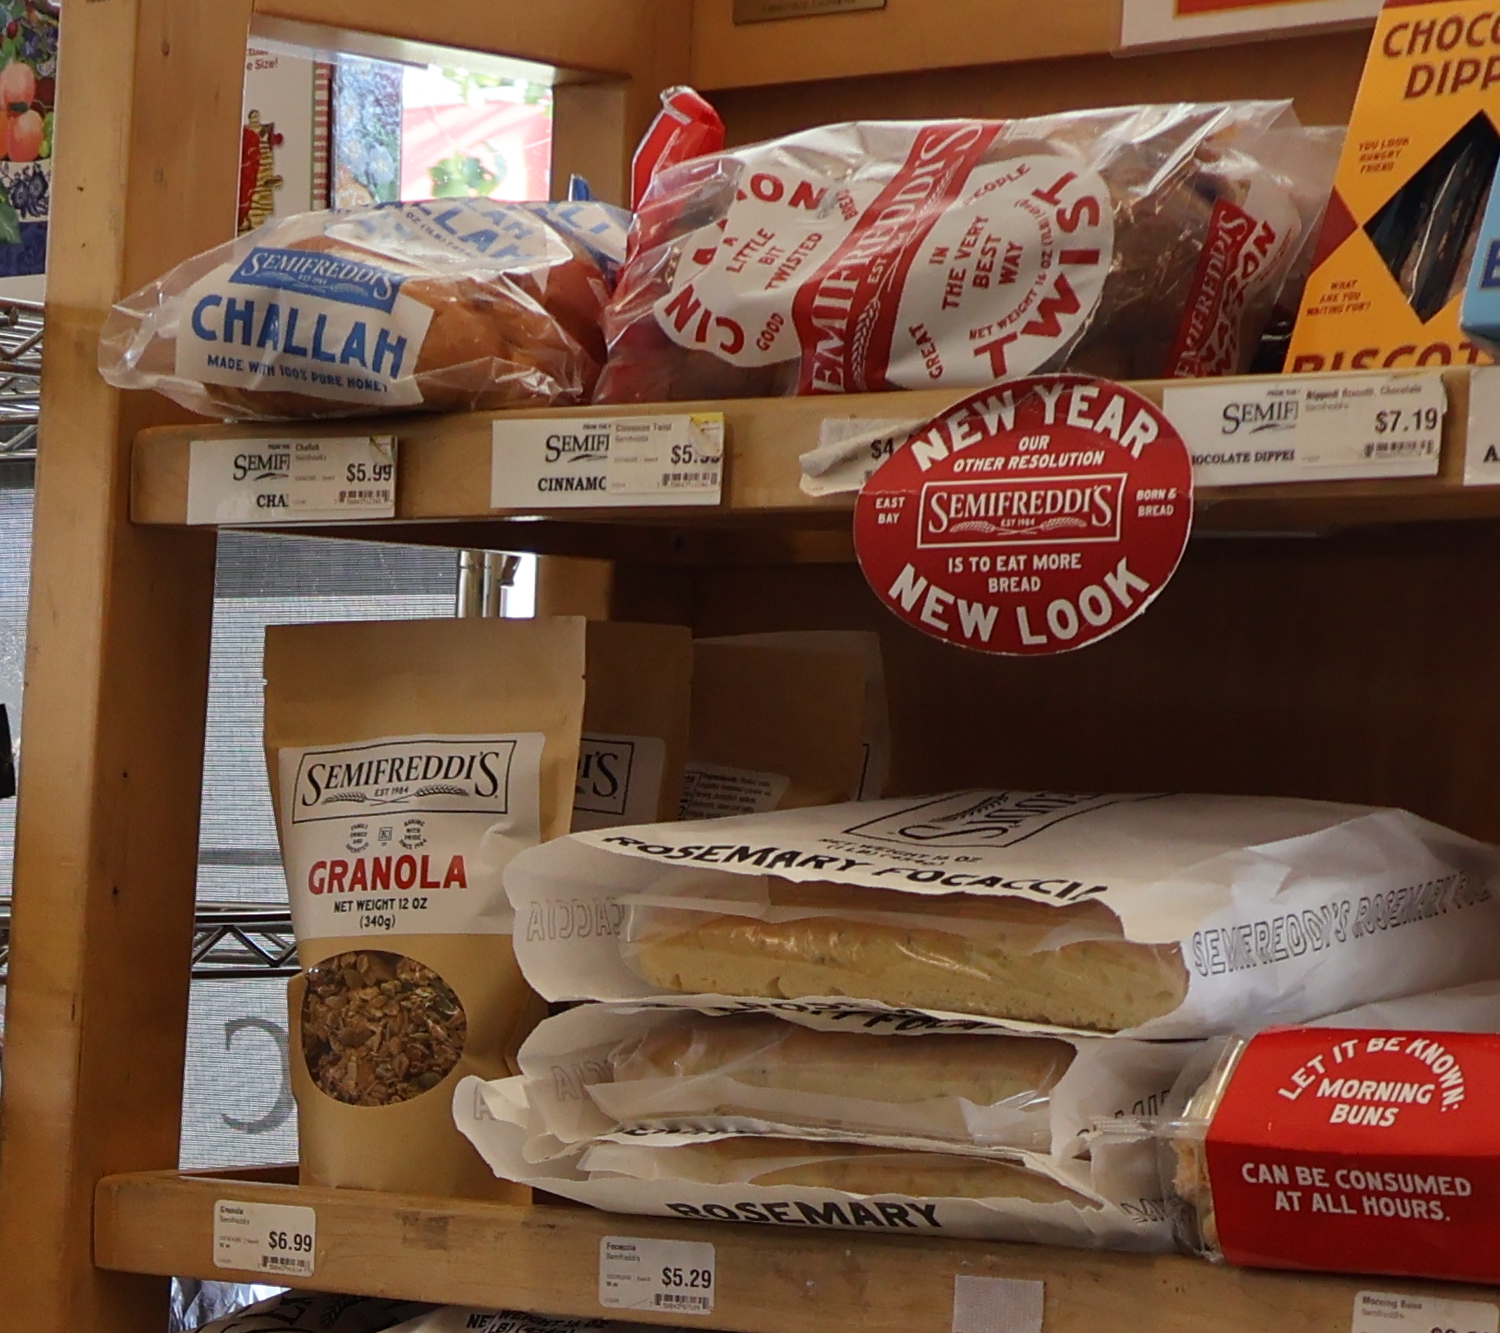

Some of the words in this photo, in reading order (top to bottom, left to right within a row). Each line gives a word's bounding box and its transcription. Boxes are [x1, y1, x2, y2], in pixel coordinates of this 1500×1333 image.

[726, 228, 775, 274] LITTLE
[760, 245, 785, 266] BIT
[954, 215, 990, 271] VERY
[240, 250, 394, 302] SEMIFREDDI'S
[765, 232, 824, 291] TWISTED
[972, 234, 1001, 290] BEST
[973, 171, 1101, 380] TWIST
[998, 241, 1025, 287] WAY
[942, 266, 969, 311] THE
[191, 294, 407, 379] CHALLAH
[206, 354, 244, 372] MADE
[248, 358, 276, 375] WITH
[278, 364, 308, 380] 100%
[312, 371, 343, 388] PURE
[911, 389, 1017, 472] NEW
[1033, 382, 1160, 460] YEAR
[1374, 407, 1438, 435] $7.19
[1018, 434, 1050, 451] OUR
[346, 461, 393, 483] $5.99
[953, 455, 1006, 473] OTHER
[1008, 450, 1105, 470] RESOLUTION
[875, 496, 906, 510] EAST
[928, 484, 1113, 534] SEMIFREDDI'S
[1136, 488, 1168, 501] BORN
[1169, 488, 1177, 499] &
[1137, 503, 1174, 517] BREAD
[878, 511, 900, 525] BAY
[948, 557, 964, 574] IS
[969, 557, 991, 573] TO
[996, 554, 1029, 572] EAT
[1032, 553, 1082, 571] MORE
[988, 576, 1041, 594] BREAD
[888, 561, 1000, 643] NEW
[1016, 557, 1151, 647] LOOK
[301, 750, 500, 806] SEMIFREDDI'S
[602, 833, 877, 877] ROSEMARY
[308, 853, 468, 896] GRANOLA
[333, 898, 354, 914] NET
[355, 897, 396, 913] WEIGHT
[397, 896, 410, 911] 12
[411, 895, 429, 910] OZ
[359, 913, 396, 931] (340g)
[1277, 1055, 1328, 1103] LET
[1332, 1038, 1359, 1062] IT
[1366, 1036, 1403, 1055] BE
[1404, 1036, 1467, 1114] KNOWN:
[1316, 1077, 1436, 1106] MORNING
[1329, 1101, 1400, 1128] BUNS
[1240, 1162, 1291, 1188] CAN
[1295, 1166, 1331, 1189] BE
[1334, 1168, 1473, 1198] CONSUMED
[665, 1201, 945, 1230] ROSEMARY
[1274, 1190, 1305, 1213] AT
[1309, 1192, 1358, 1216] ALL
[1362, 1195, 1453, 1223] HOURS.
[660, 1266, 713, 1290] $5.29
